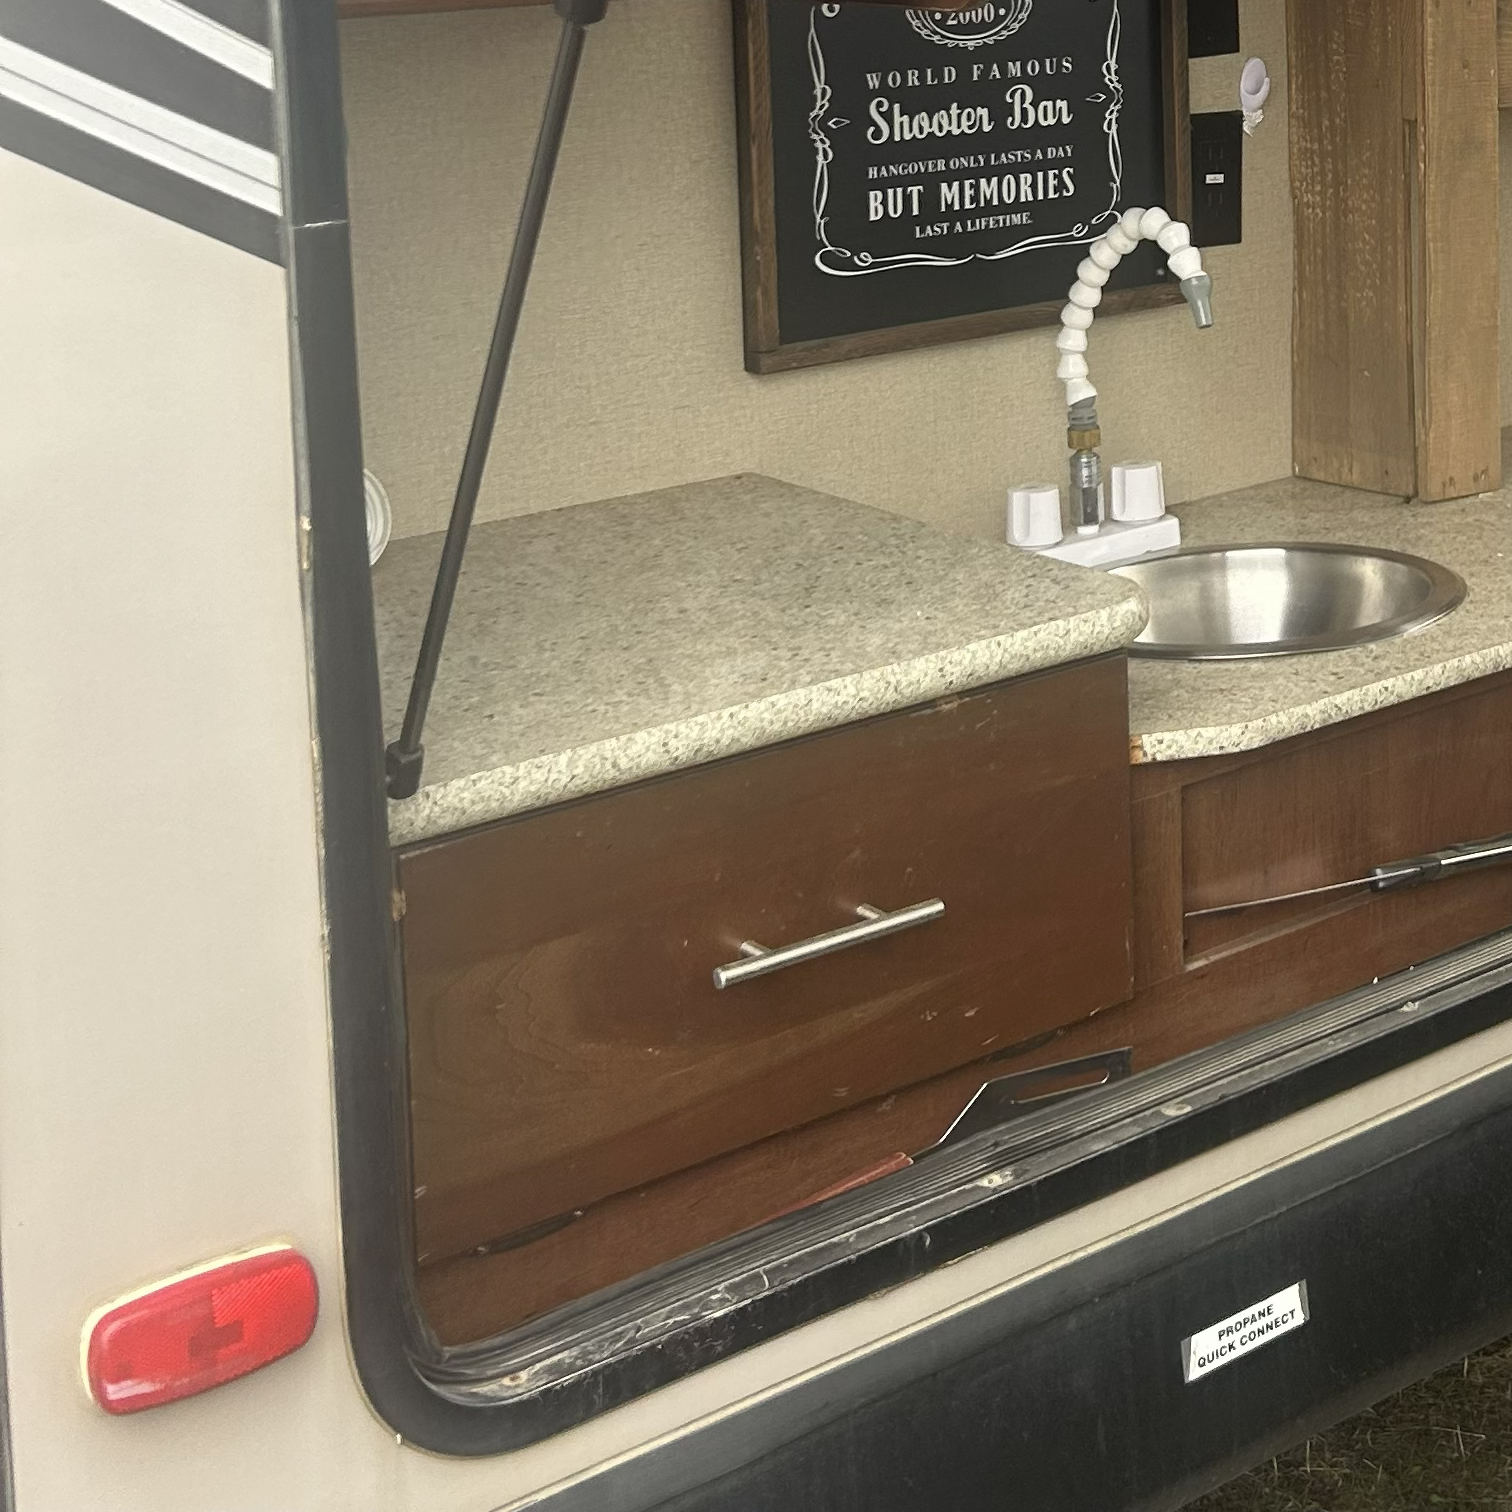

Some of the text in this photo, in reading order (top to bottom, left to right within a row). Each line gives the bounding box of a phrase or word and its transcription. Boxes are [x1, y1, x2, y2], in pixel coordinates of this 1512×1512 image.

[865, 56, 1074, 90] WORLD FAMOUS
[866, 83, 1074, 145] Shooter Bar
[867, 144, 1074, 180] HANGOVER ONLY LASTS A DAY
[868, 166, 1076, 222] BUT MEMORIES
[914, 222, 950, 239] LAST
[953, 220, 964, 234] A
[1197, 1308, 1296, 1369] QUICK CONNECT
[1217, 1304, 1274, 1341] PROPANE
